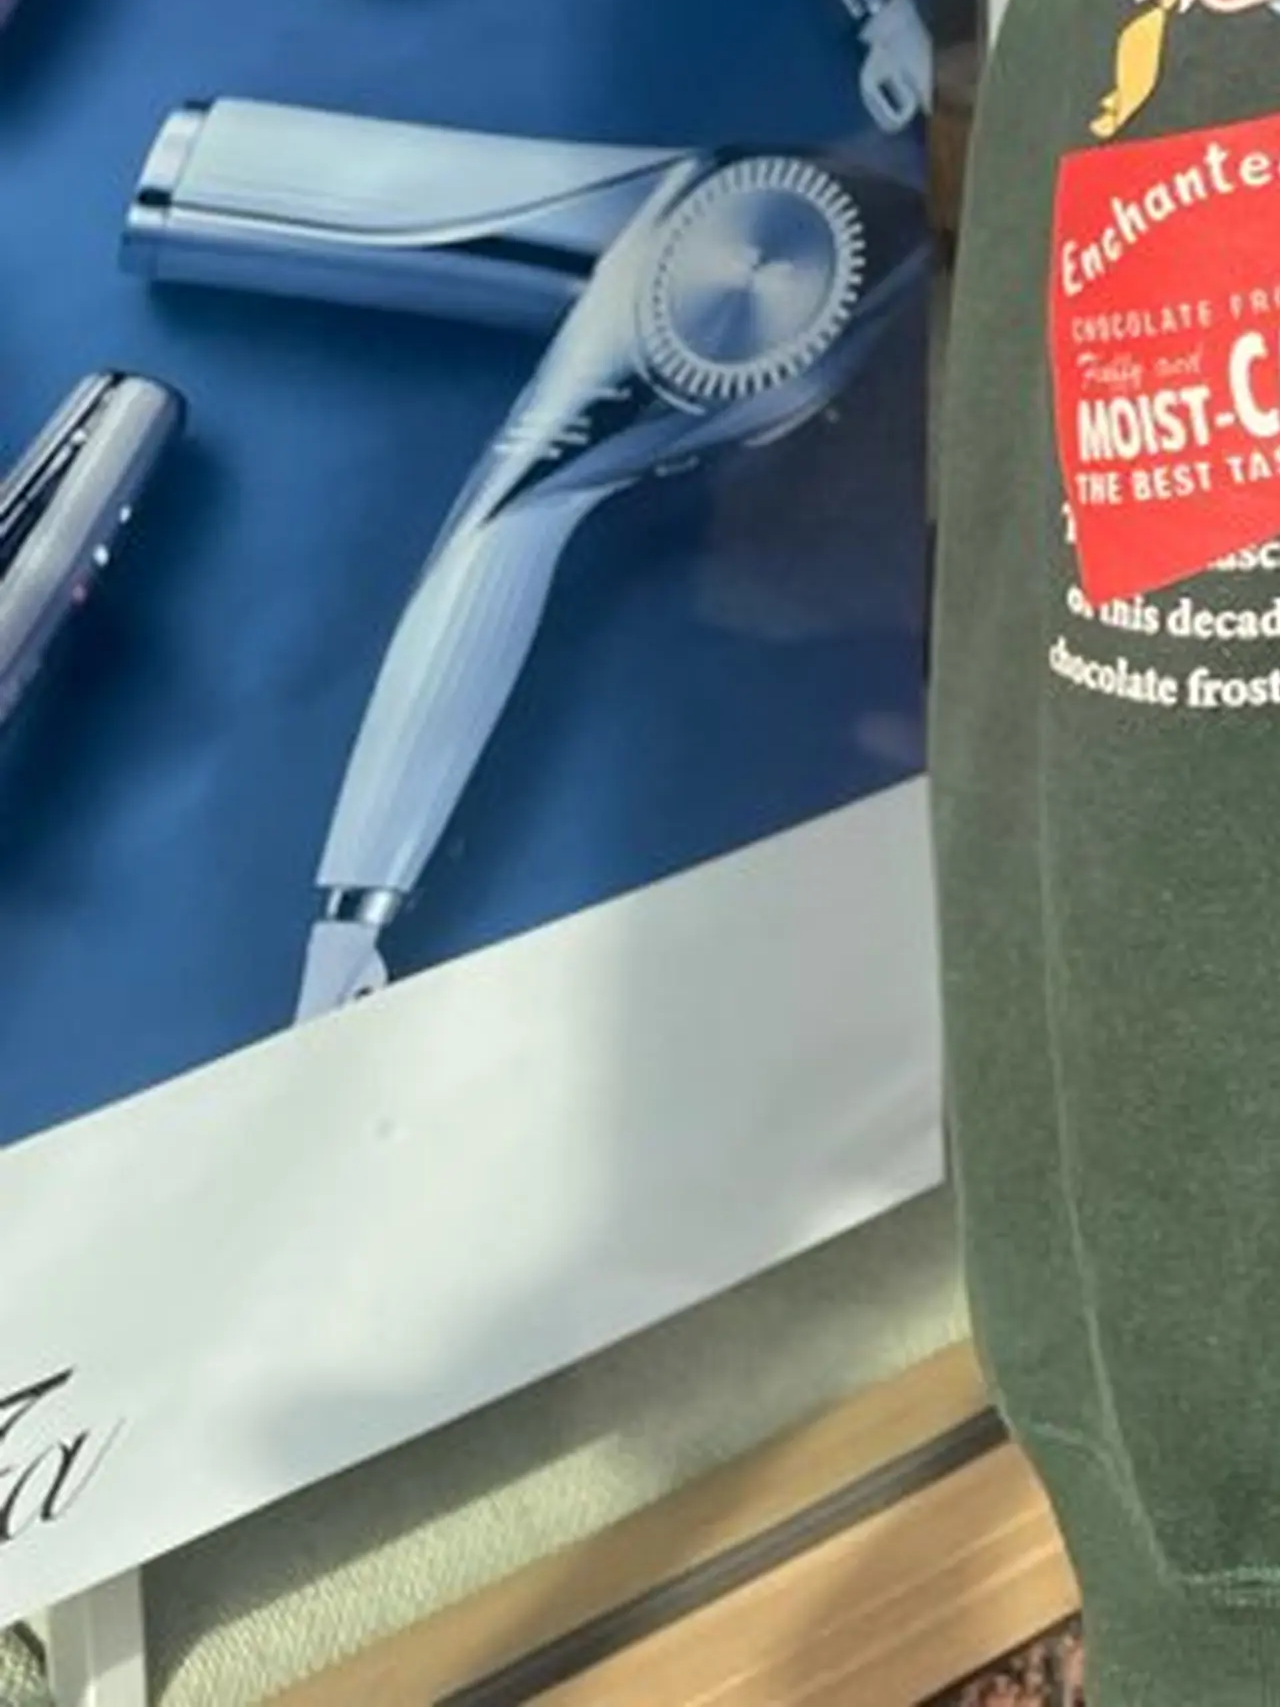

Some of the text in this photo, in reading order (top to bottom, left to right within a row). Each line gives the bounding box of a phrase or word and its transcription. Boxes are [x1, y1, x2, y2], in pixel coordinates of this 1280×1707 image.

[1071, 299, 1213, 346] CHOCOLATE
[1074, 470, 1123, 505] THE
[1131, 461, 1213, 502] BEST
